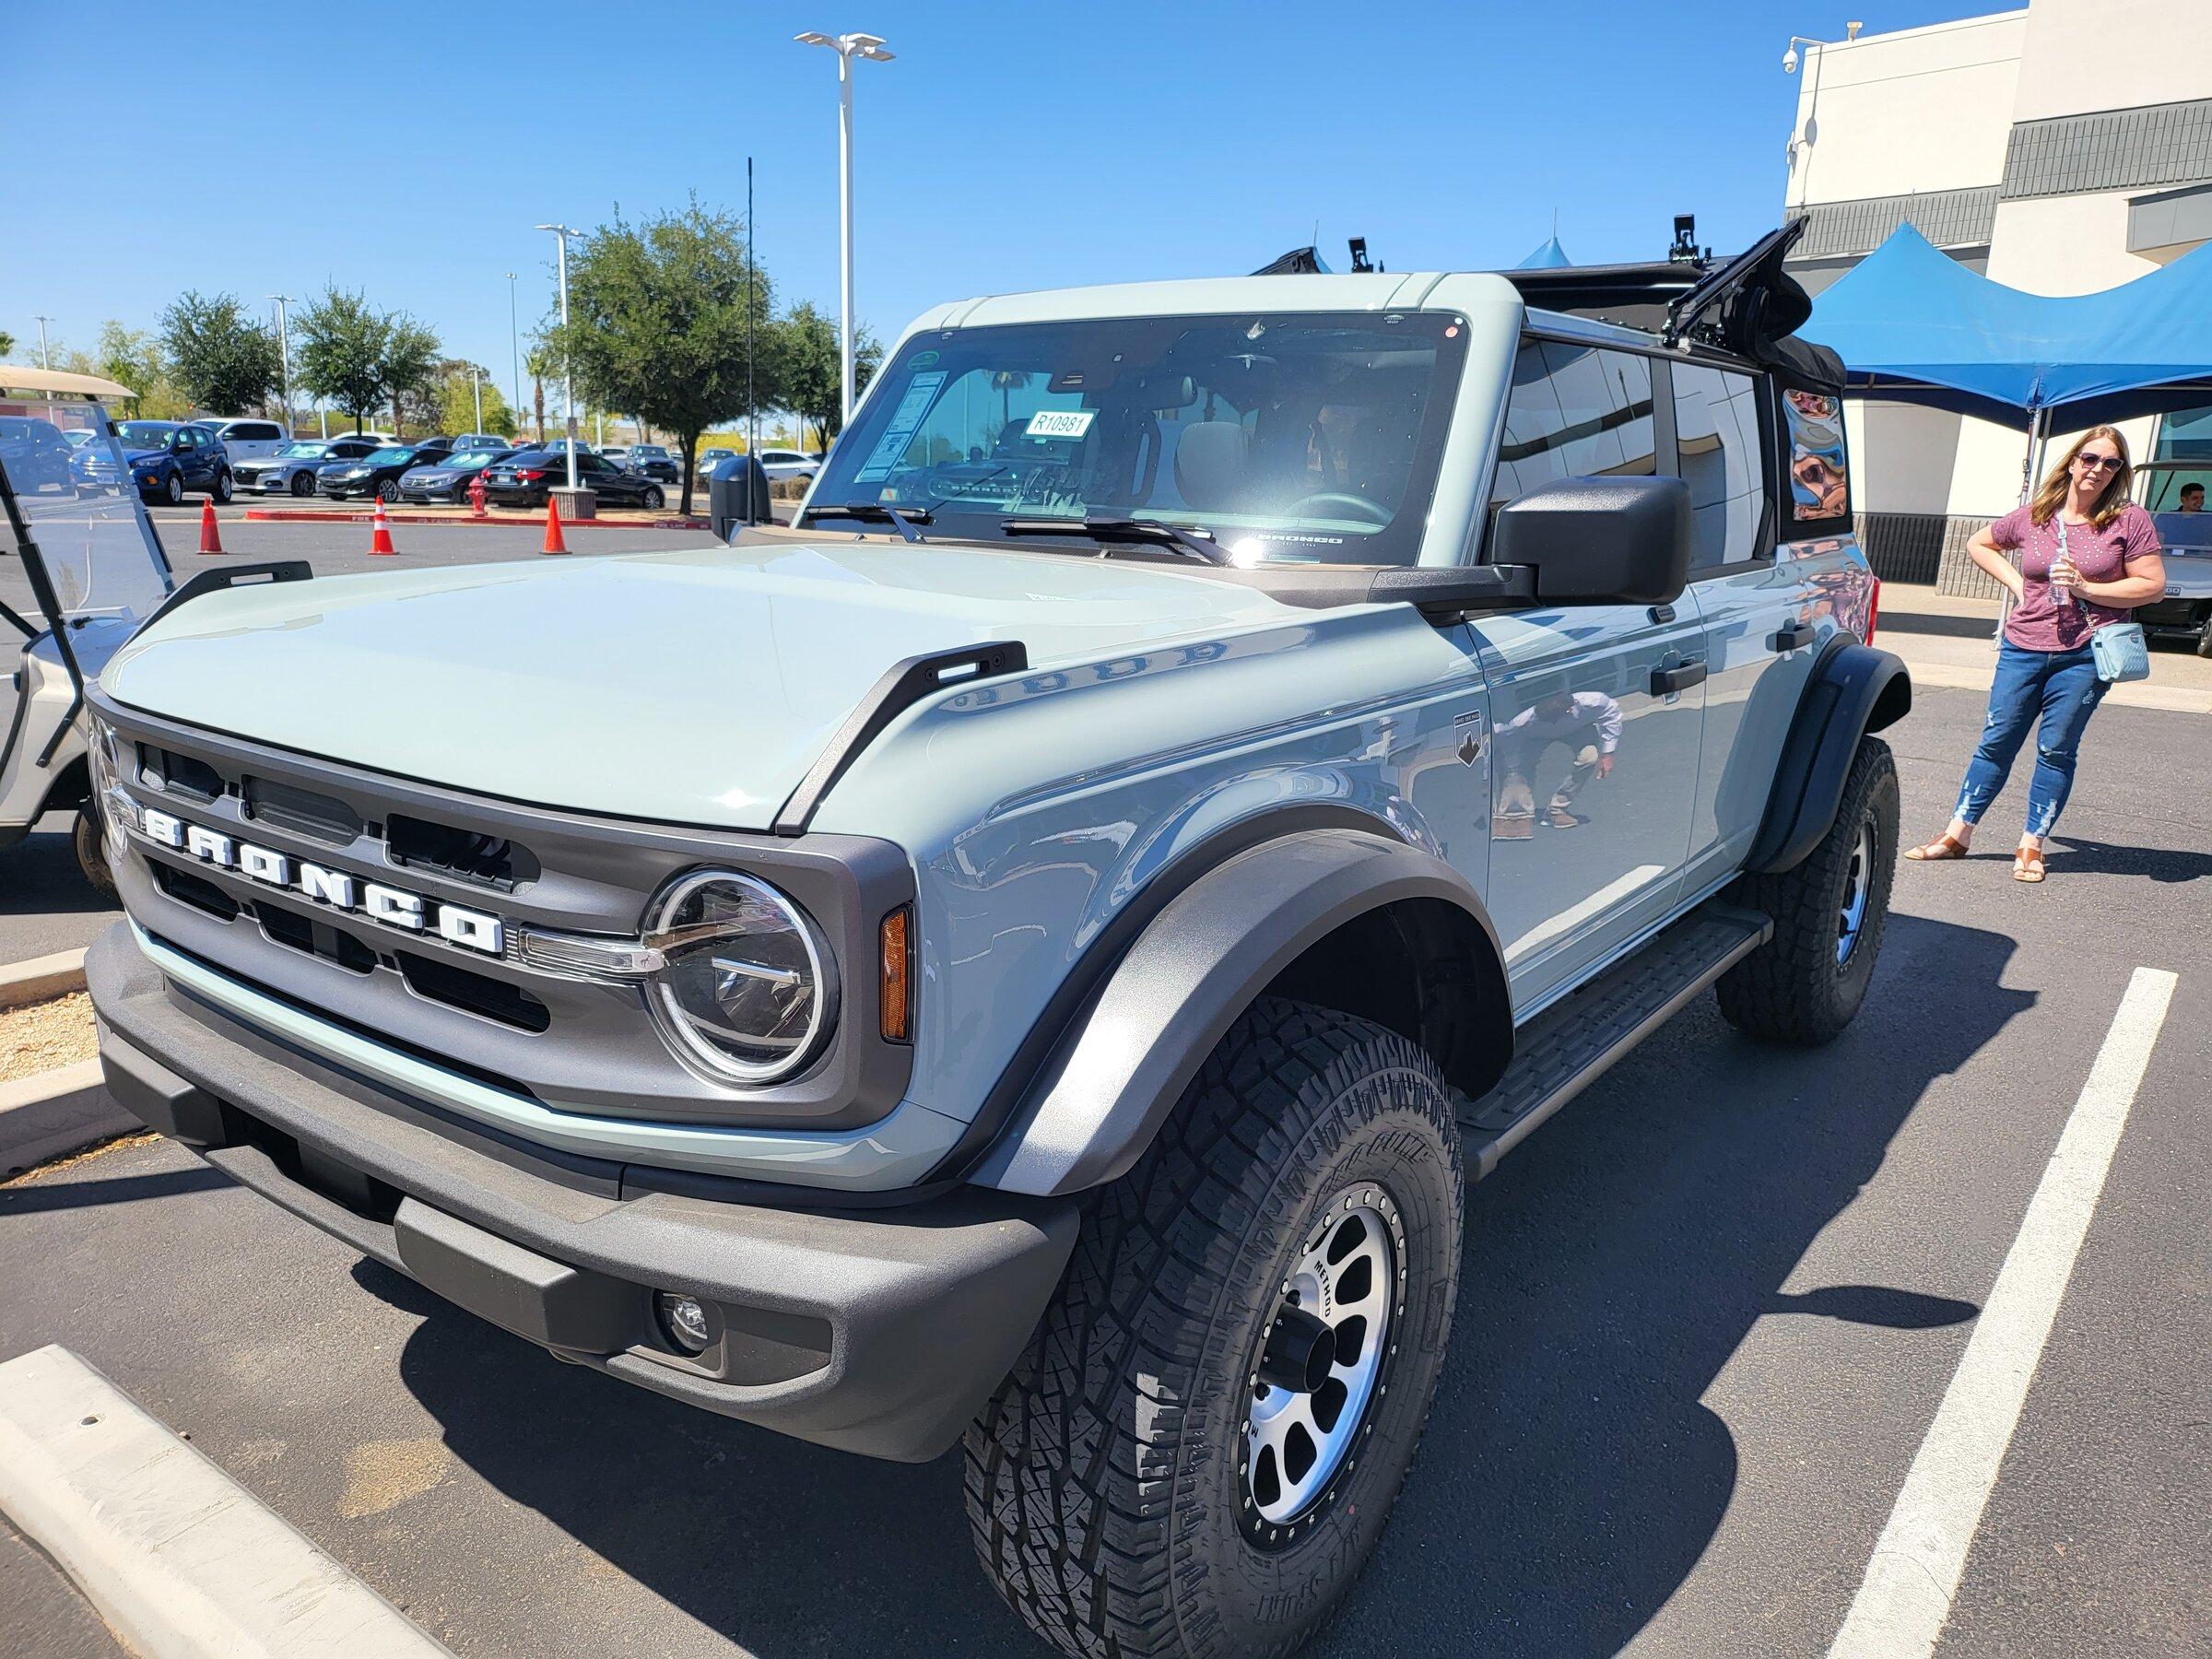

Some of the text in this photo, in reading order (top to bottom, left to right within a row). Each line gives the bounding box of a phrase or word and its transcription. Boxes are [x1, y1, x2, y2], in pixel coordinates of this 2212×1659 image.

[1034, 414, 1085, 432] R10981
[1256, 534, 1344, 544] BRONCO
[145, 808, 504, 954] BRONCO
[1313, 1260, 1332, 1318] METHOD
